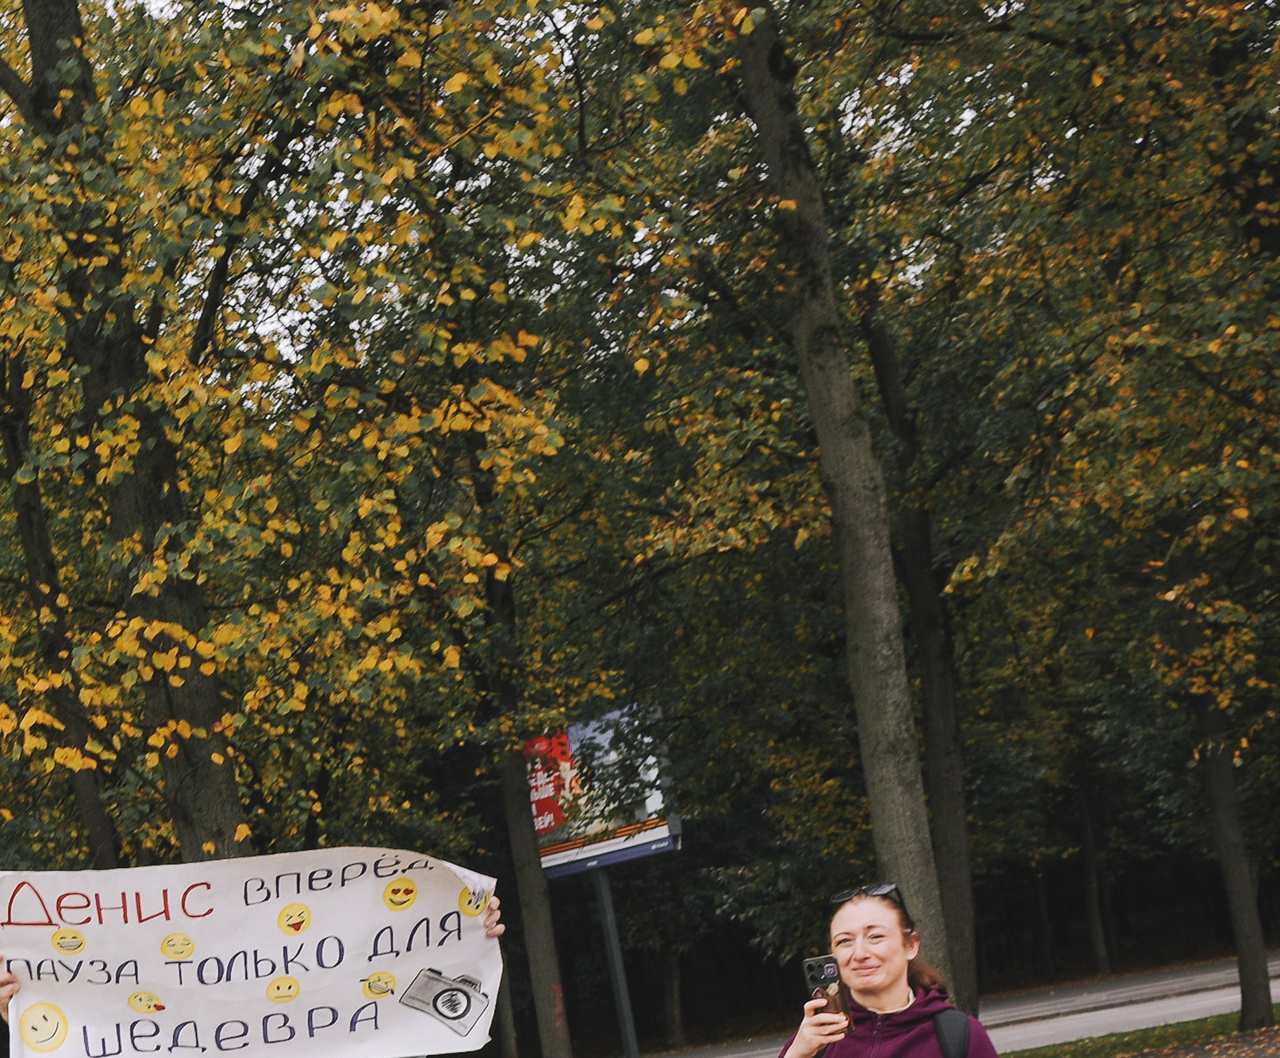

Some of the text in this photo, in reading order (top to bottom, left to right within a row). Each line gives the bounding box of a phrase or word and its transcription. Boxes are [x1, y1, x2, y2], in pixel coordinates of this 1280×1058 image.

[6, 910, 462, 985] ПАУЗА ТОЛЬКО ДЛЯ
